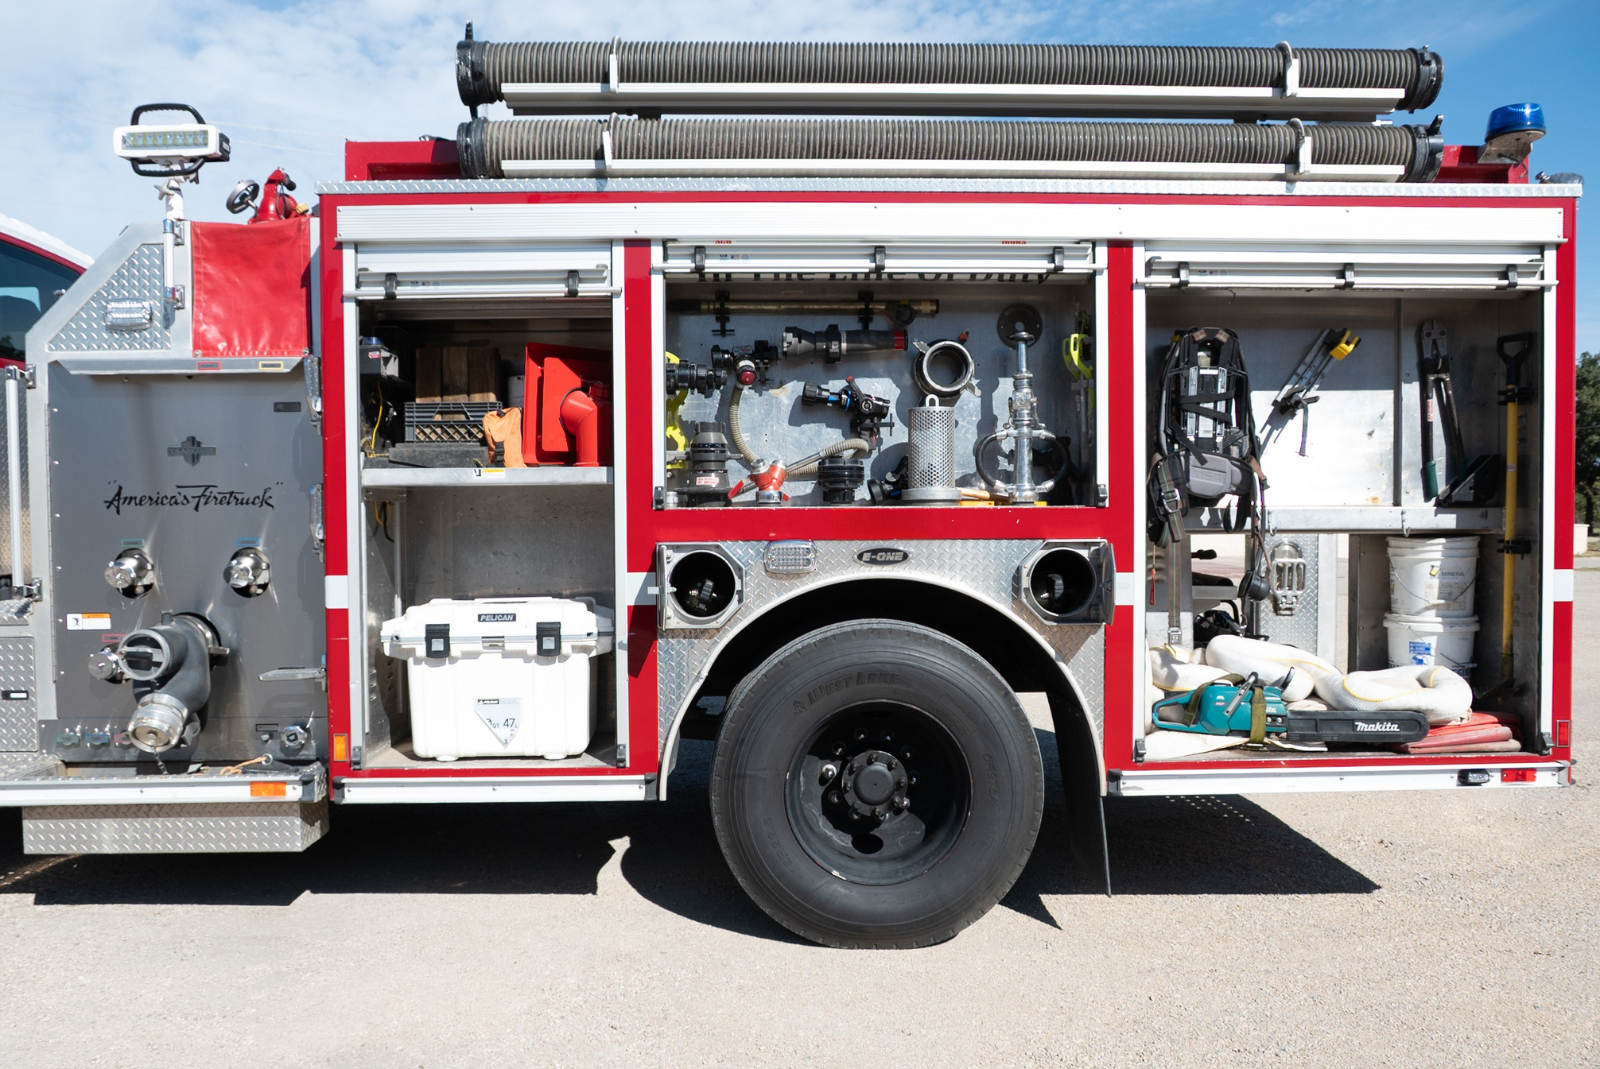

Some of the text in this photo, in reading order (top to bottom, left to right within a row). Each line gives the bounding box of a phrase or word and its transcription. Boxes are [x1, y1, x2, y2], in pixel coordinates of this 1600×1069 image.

[862, 551, 904, 562] E-ONE
[480, 614, 514, 622] PELICAN
[855, 671, 901, 685] LAKE
[1354, 721, 1401, 732] Makita
